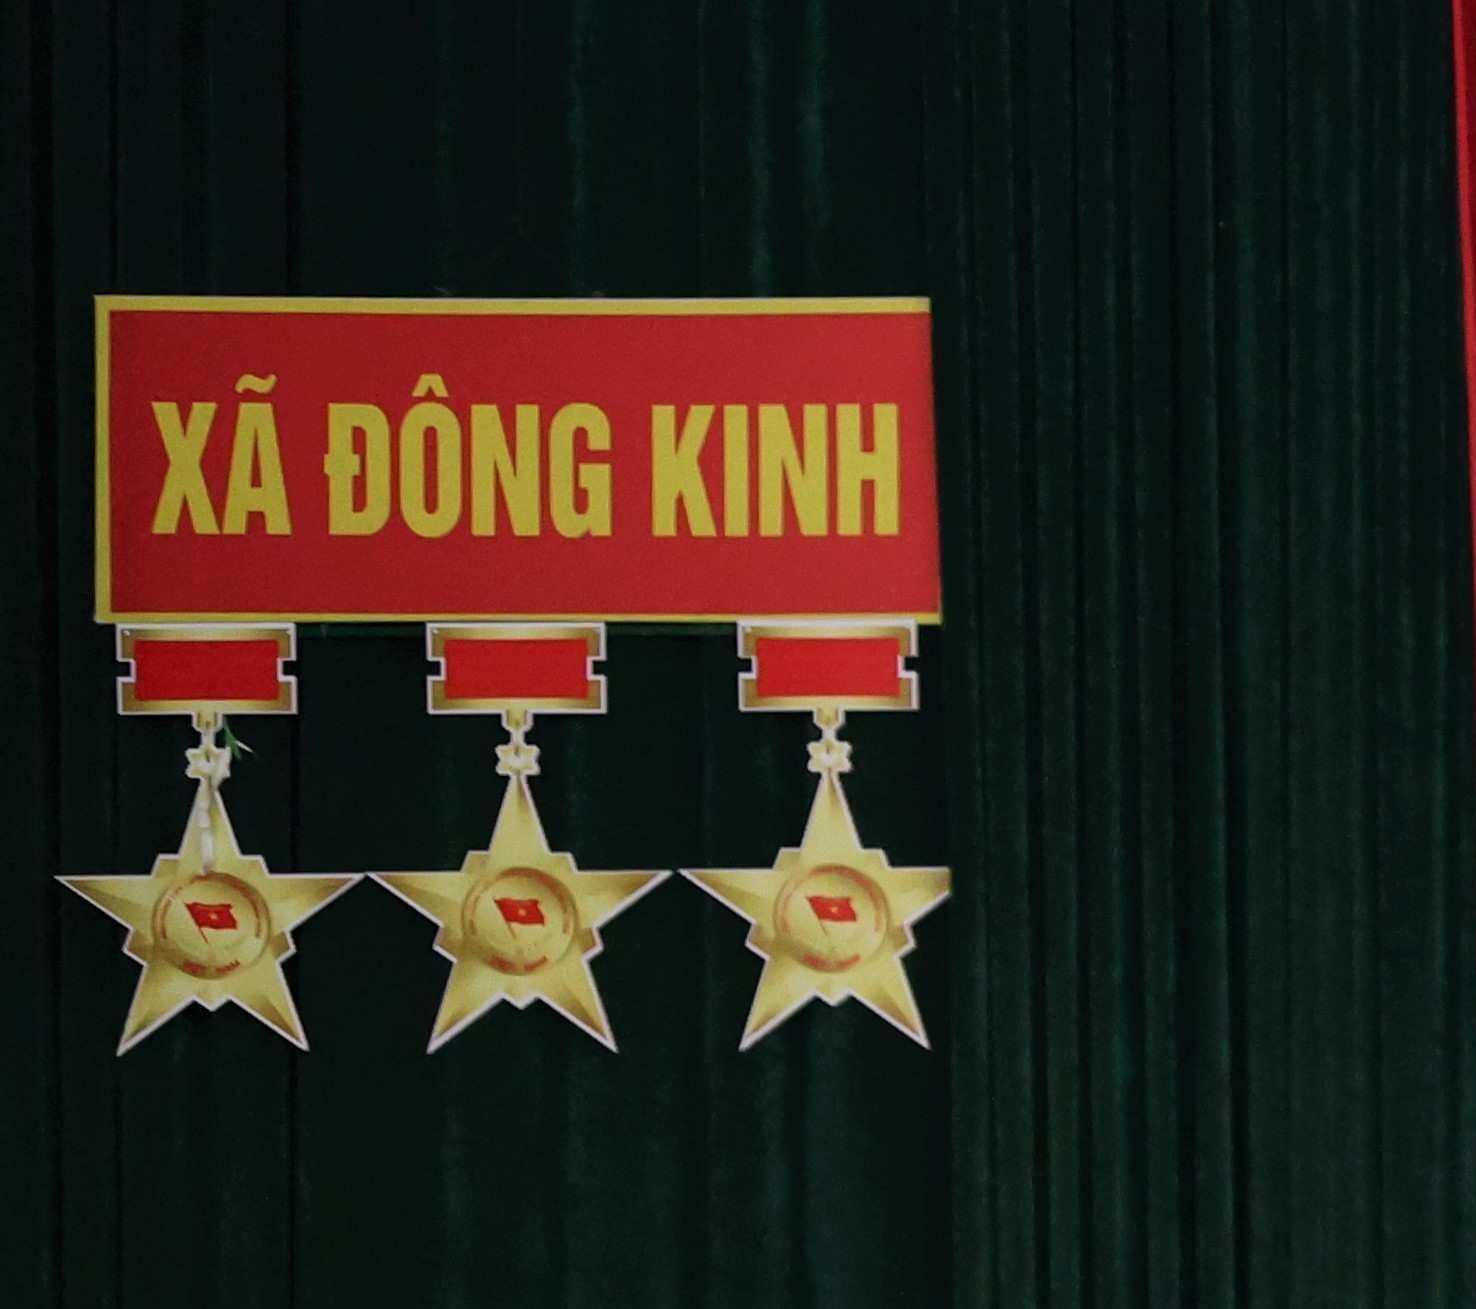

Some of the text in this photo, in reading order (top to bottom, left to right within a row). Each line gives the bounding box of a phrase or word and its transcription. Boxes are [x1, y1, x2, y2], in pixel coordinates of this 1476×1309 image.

[152, 374, 899, 537] XÃ ĐÔNG KINH
